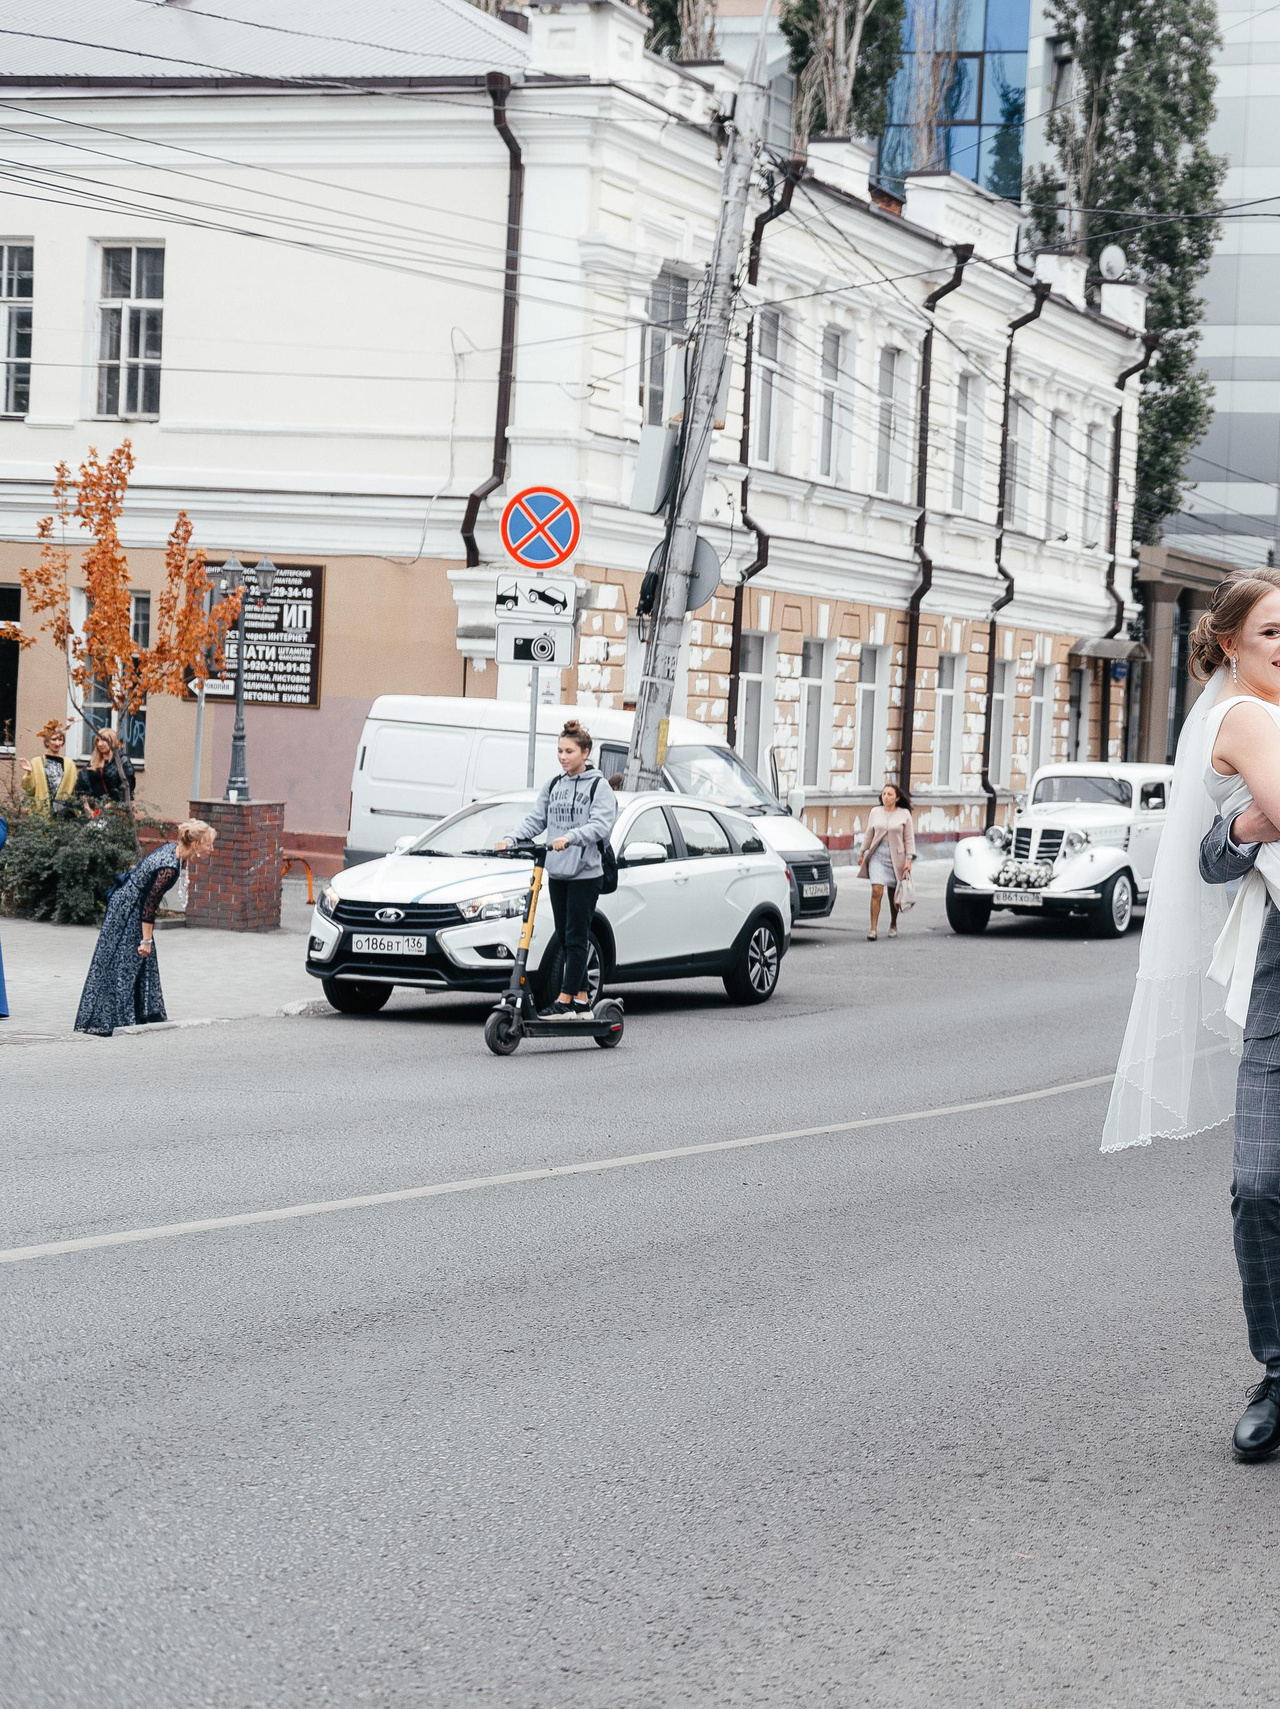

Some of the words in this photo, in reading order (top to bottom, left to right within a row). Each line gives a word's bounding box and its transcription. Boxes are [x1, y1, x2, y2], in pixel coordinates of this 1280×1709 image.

[283, 604, 312, 629] ИП
[268, 633, 308, 643] ИНТЕРНЕТ
[243, 672, 271, 681] ИЗИТКИ,
[272, 673, 311, 683] ЛИСТОВКИ
[243, 681, 276, 692] АБЛИЧКИ,
[243, 691, 280, 702] ВЕТОВЫЕ
[282, 693, 310, 703] БУКВЫ
[355, 937, 402, 952] О186ВТ
[404, 937, 423, 949] 136
